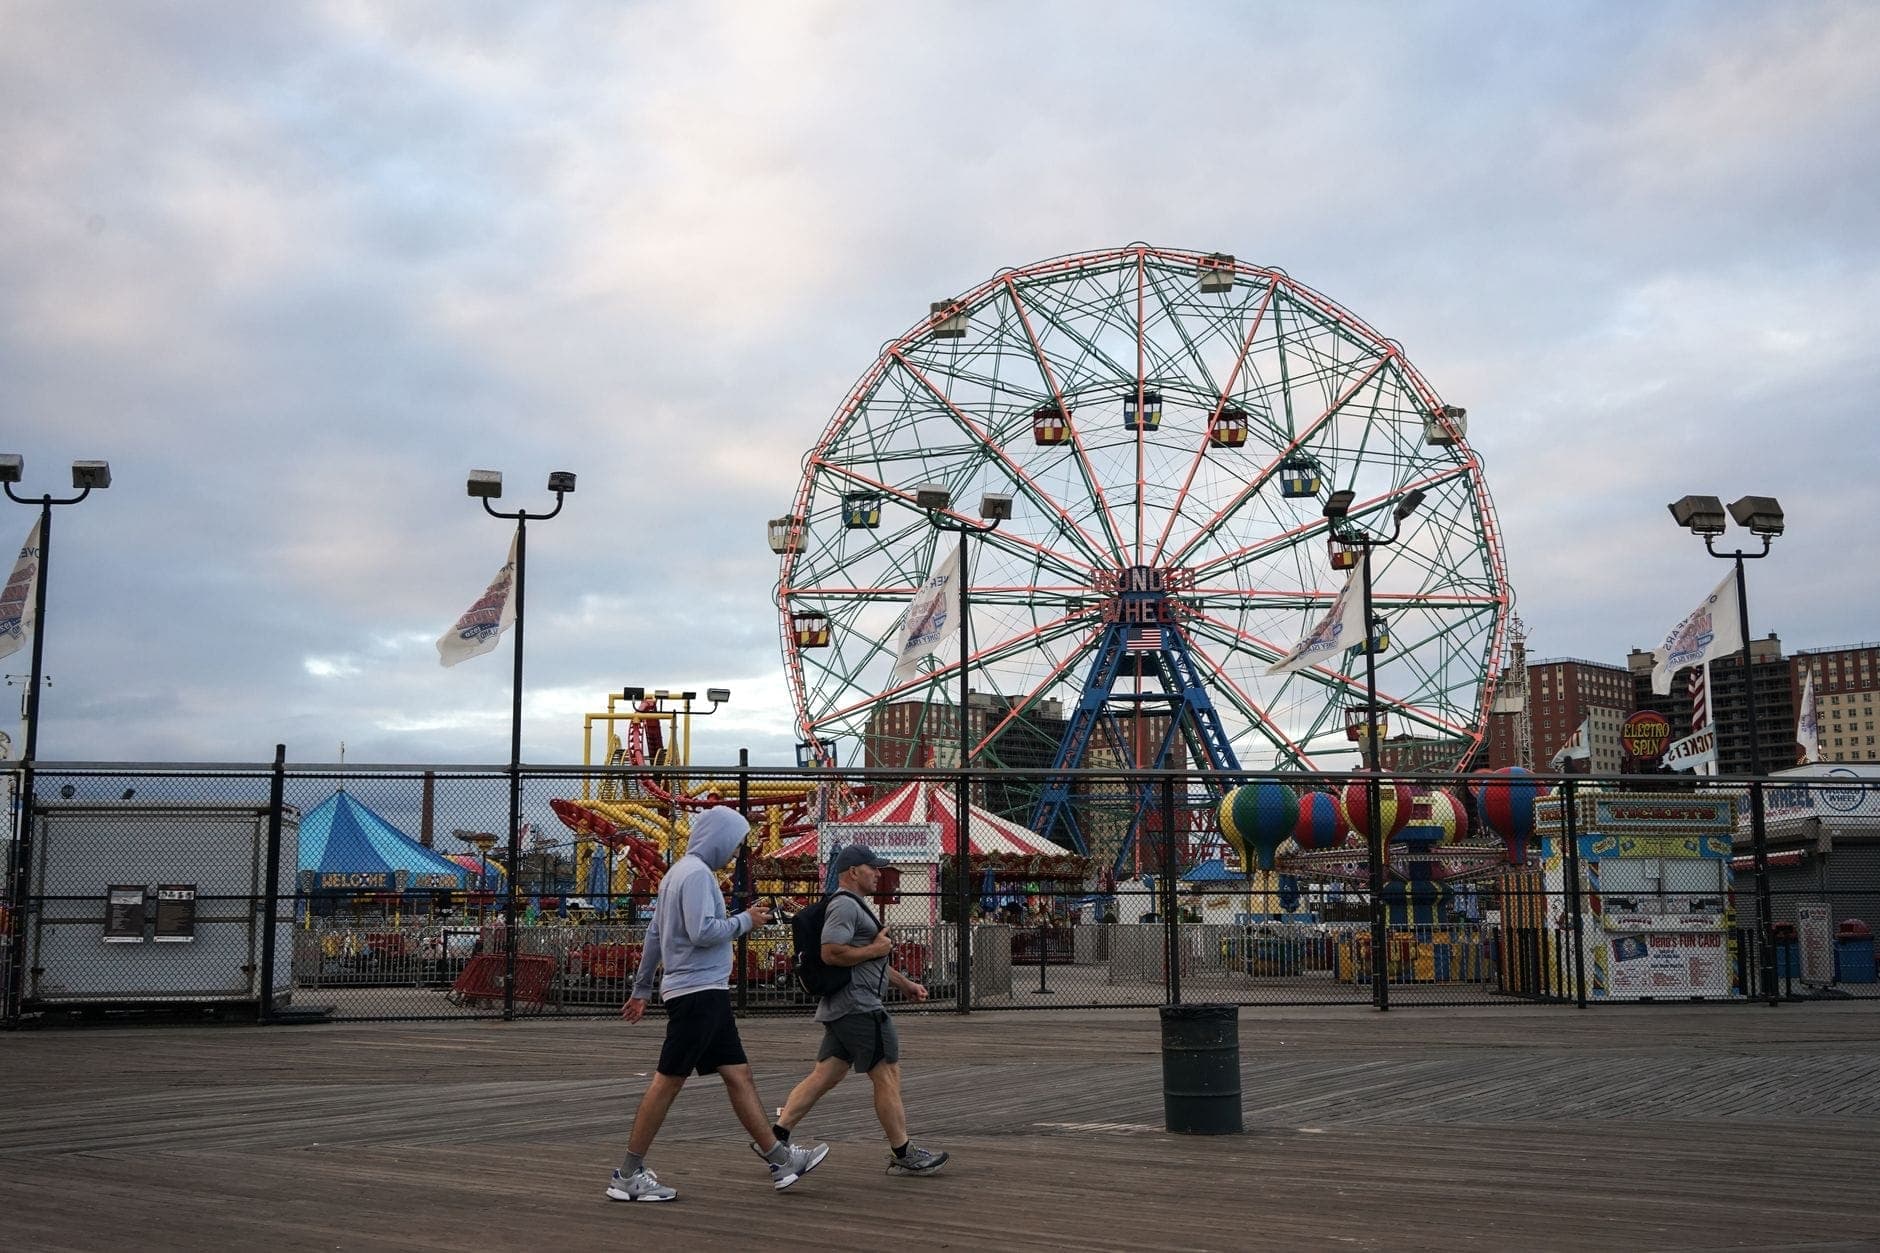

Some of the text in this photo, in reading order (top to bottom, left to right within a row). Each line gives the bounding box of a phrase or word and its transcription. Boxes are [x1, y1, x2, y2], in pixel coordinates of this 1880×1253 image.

[1091, 567, 1195, 592] WONDER
[1101, 597, 1189, 623] WHEEL
[1623, 723, 1670, 738] ELECTRO
[1632, 739, 1660, 756] SPIN
[1769, 782, 1815, 808] WHEEL
[1610, 806, 1718, 821] TICKETS
[321, 873, 387, 889] WELCOME
[1680, 934, 1697, 948] FUN
[1699, 934, 1721, 948] CARD
